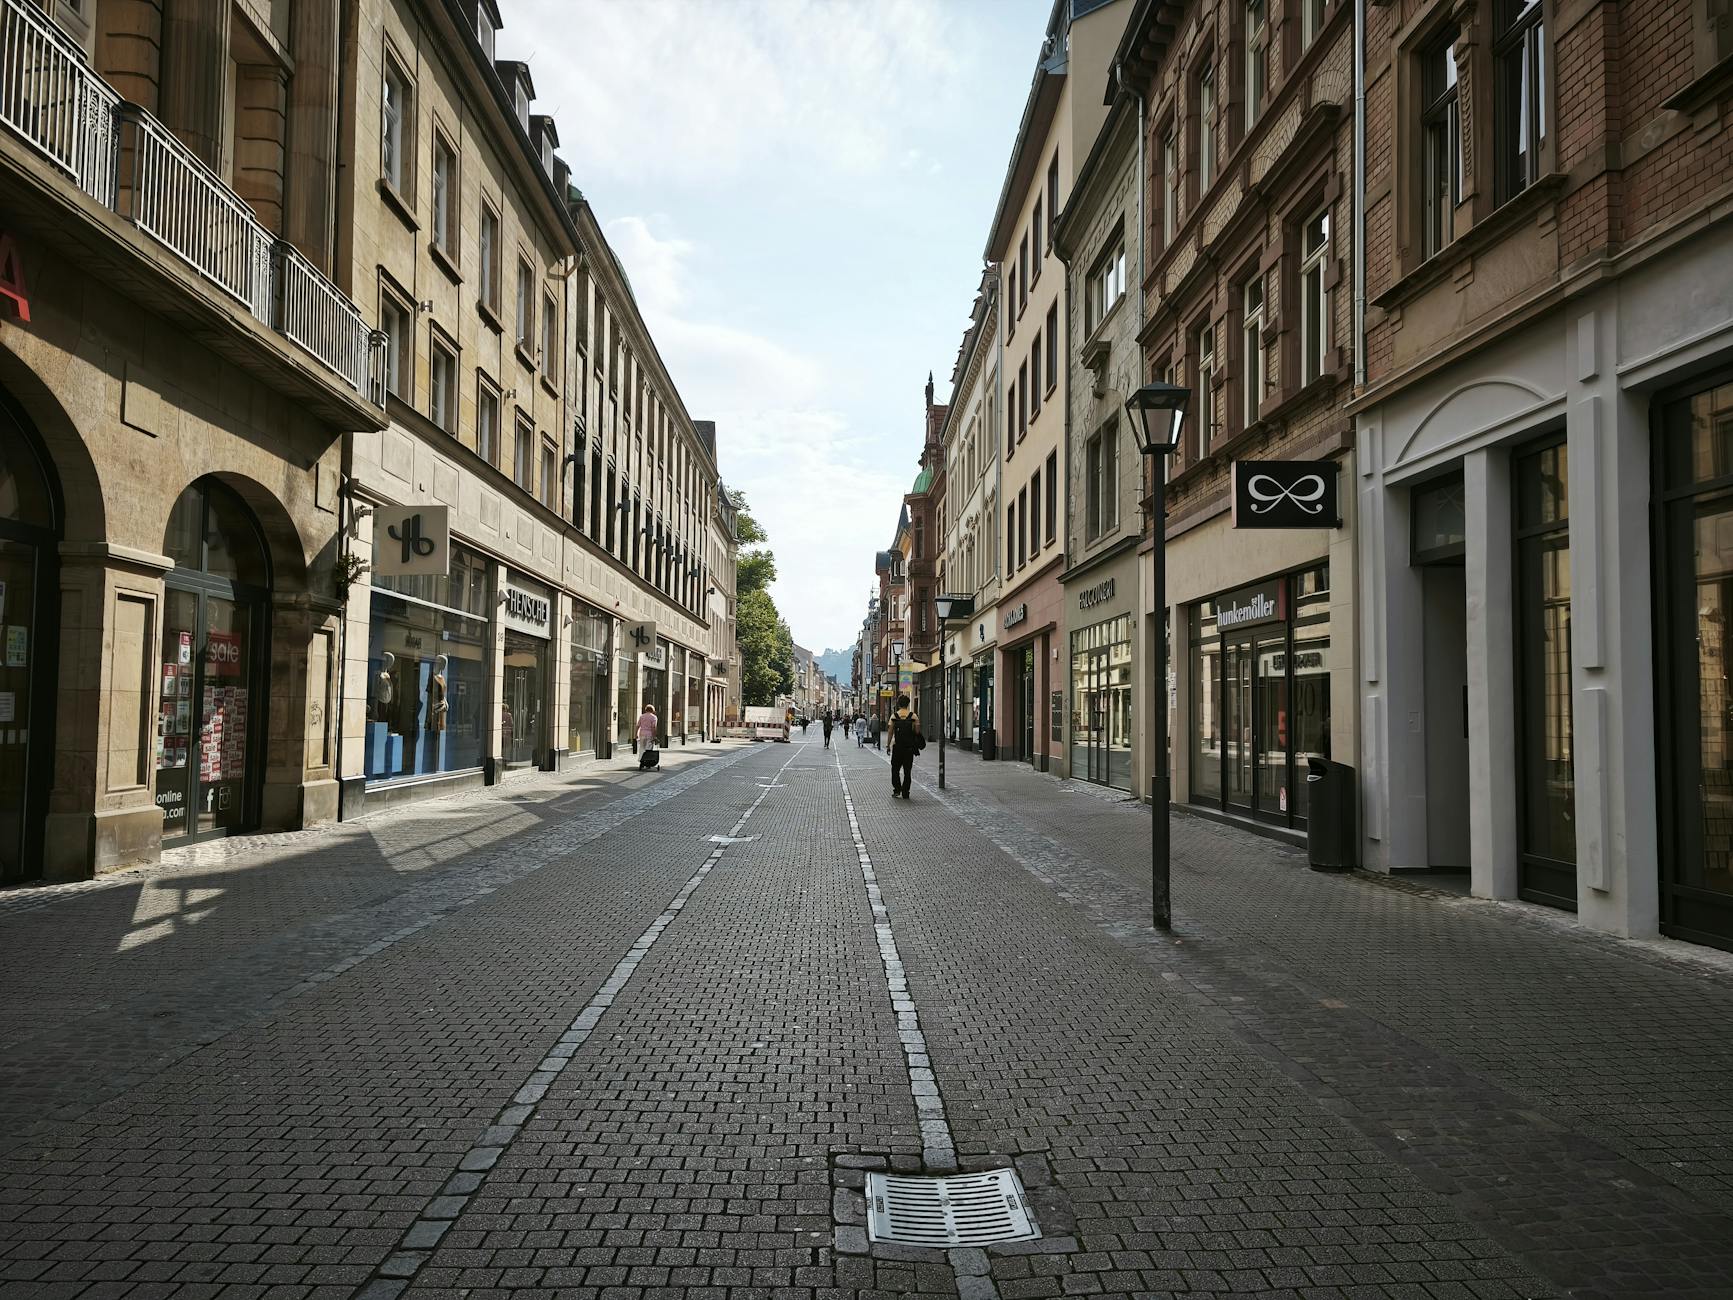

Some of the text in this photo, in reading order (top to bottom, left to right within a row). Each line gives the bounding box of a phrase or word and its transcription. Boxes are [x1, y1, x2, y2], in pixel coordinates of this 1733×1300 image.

[1217, 593, 1275, 627] hunkemöller
[210, 641, 239, 663] sale
[156, 789, 183, 804] online
